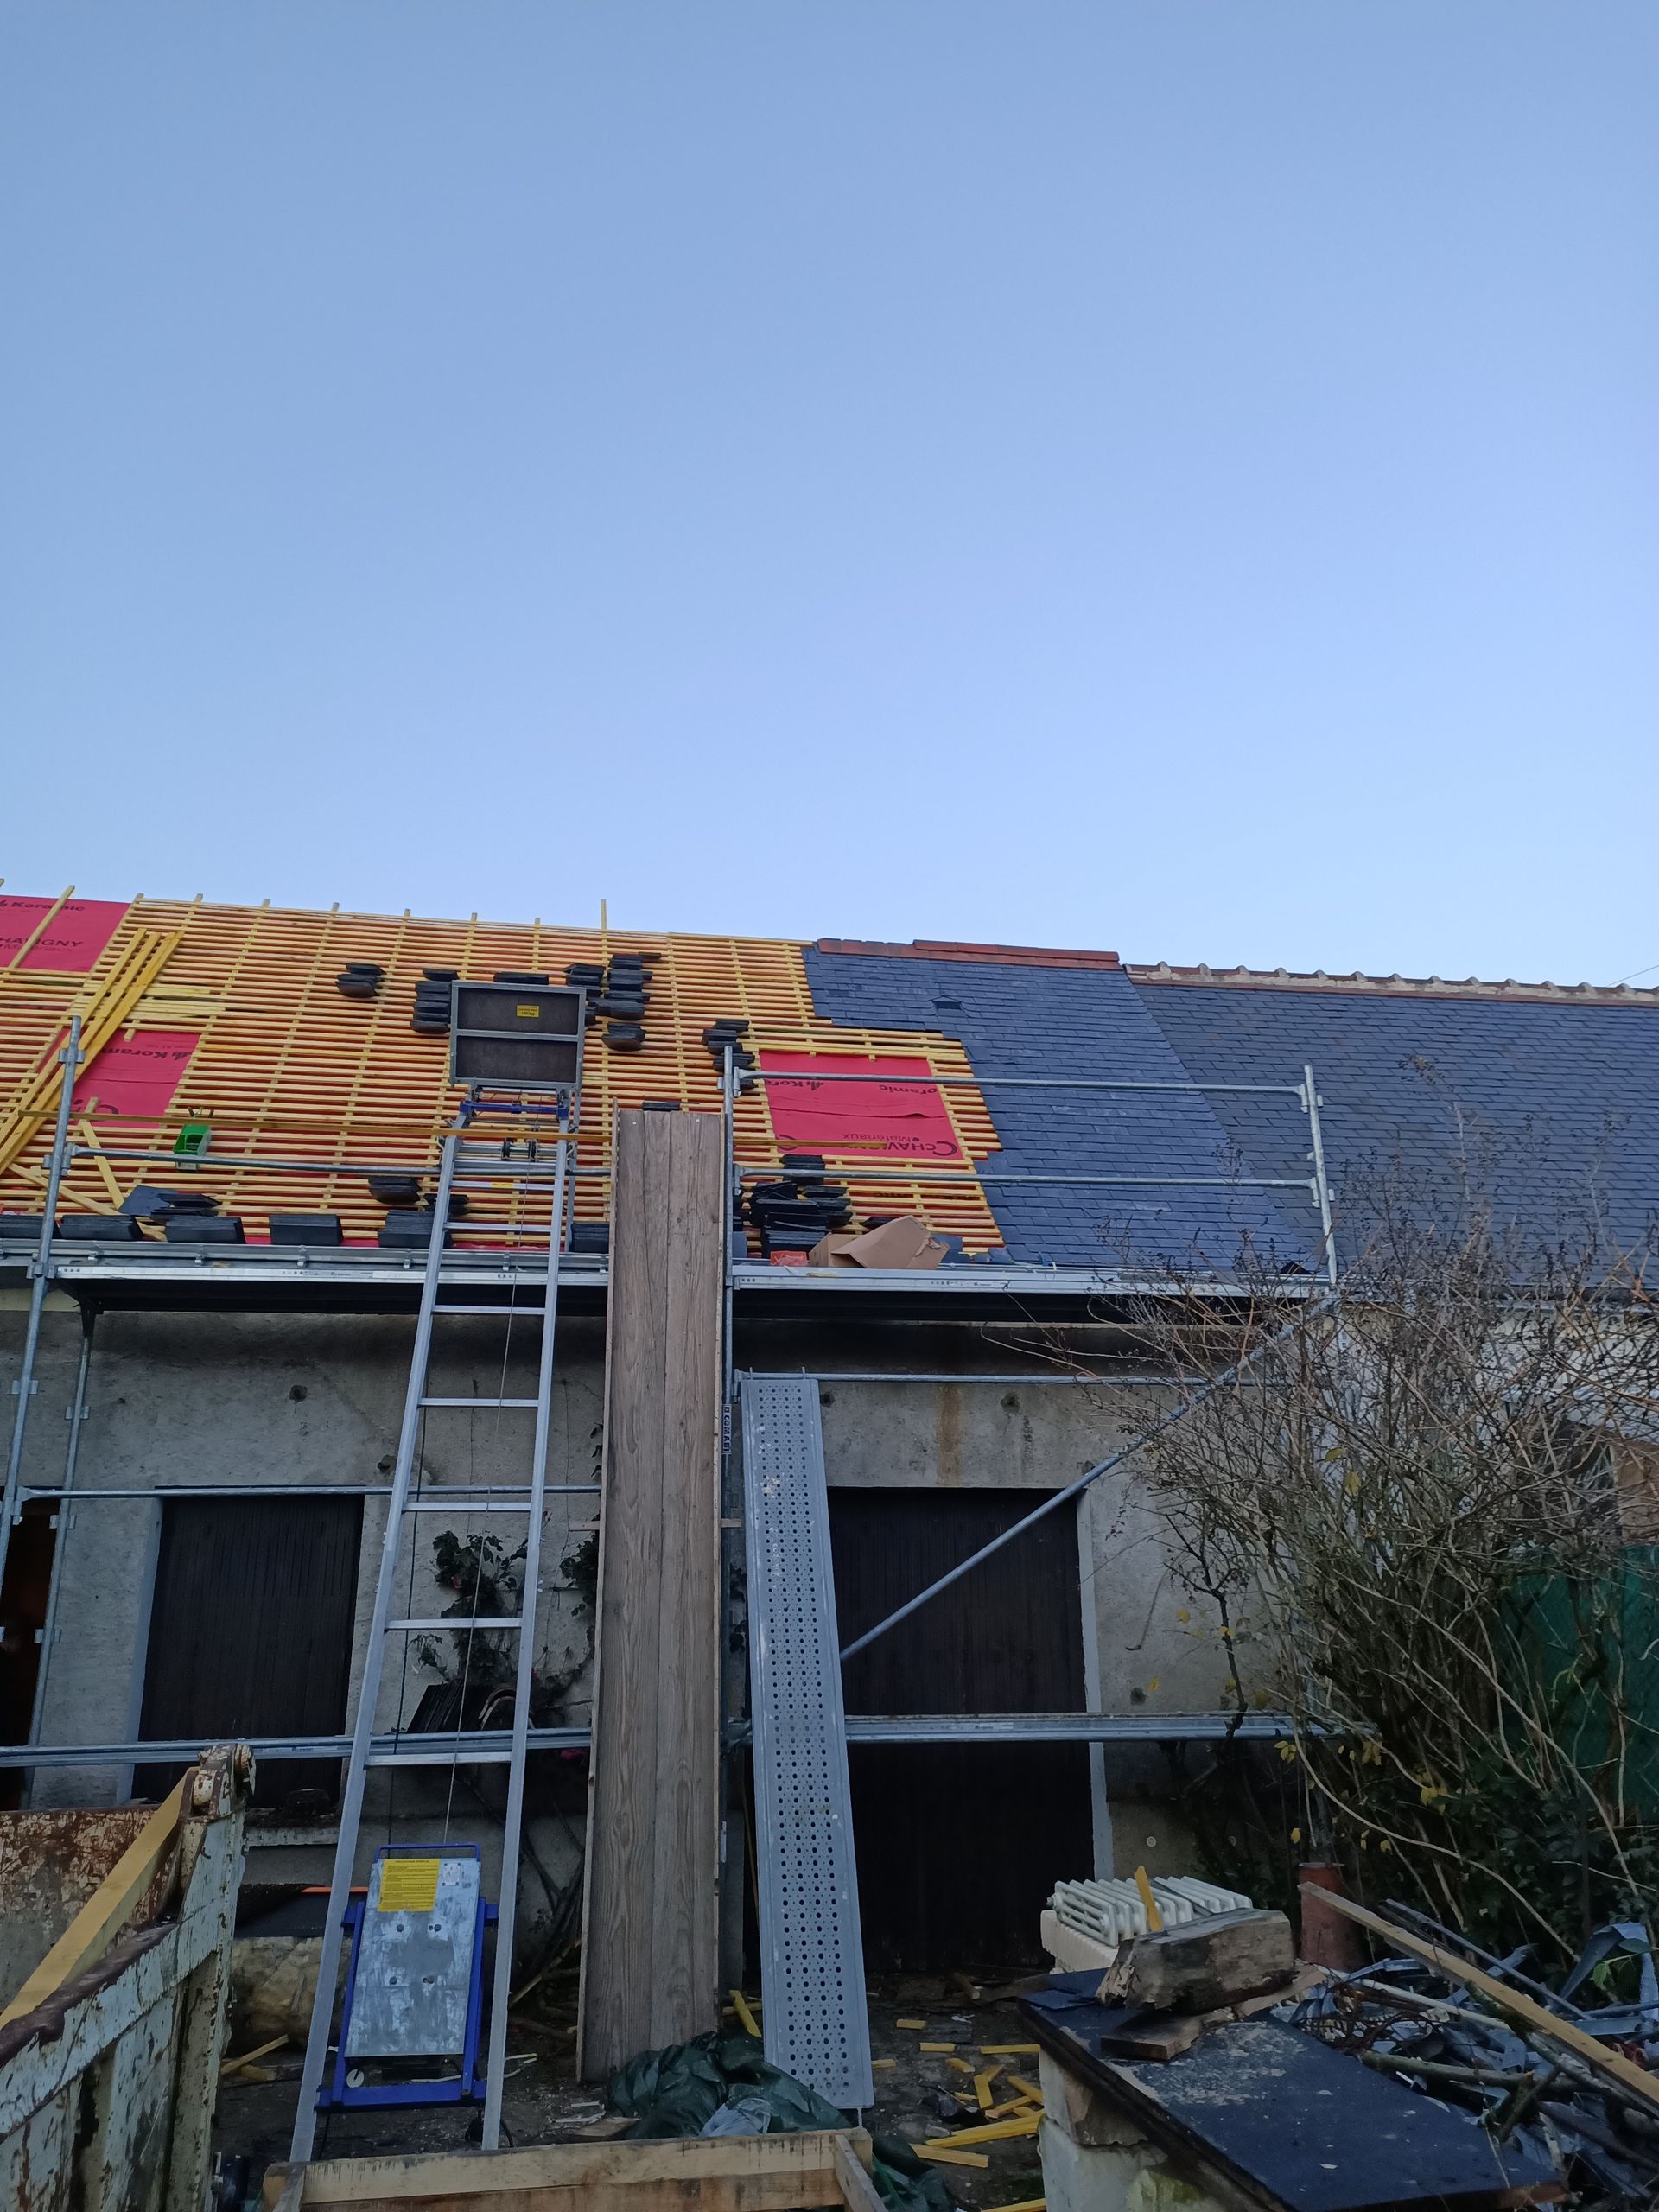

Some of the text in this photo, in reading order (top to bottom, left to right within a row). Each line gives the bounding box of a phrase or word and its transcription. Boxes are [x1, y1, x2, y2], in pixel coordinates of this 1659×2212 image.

[0, 937, 83, 947] HAIGNY
[100, 1047, 168, 1059] Koram
[878, 1084, 937, 1095] oramic
